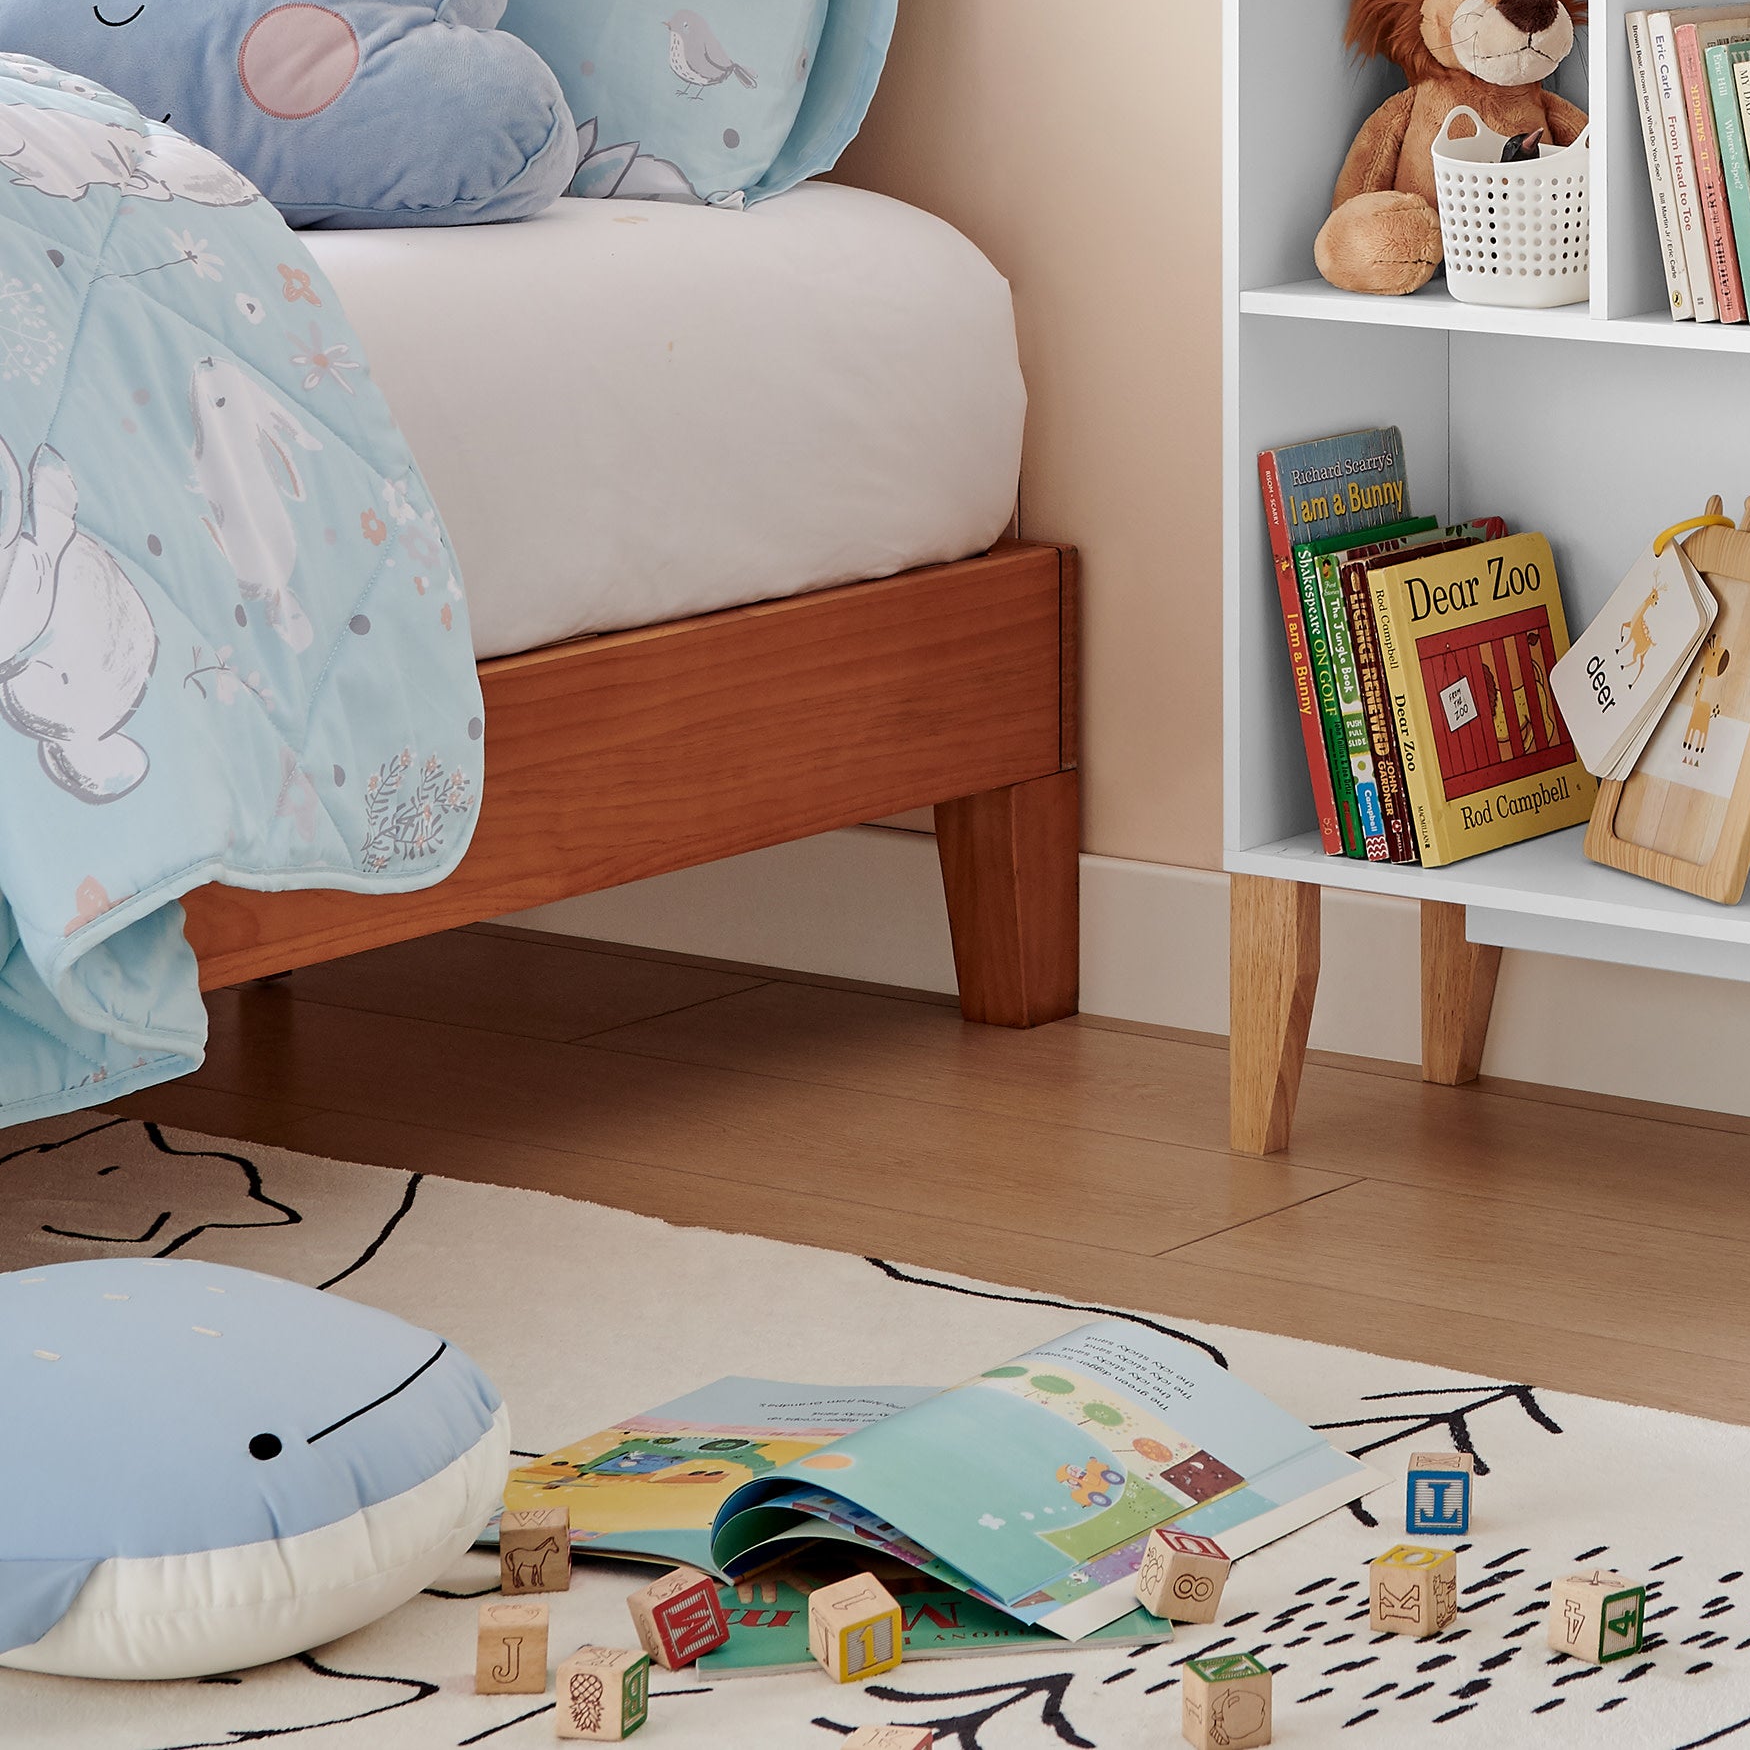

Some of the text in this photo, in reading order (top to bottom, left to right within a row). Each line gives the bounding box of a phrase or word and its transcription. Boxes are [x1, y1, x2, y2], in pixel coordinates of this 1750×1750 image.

[1632, 25, 1640, 49] Brown
[1640, 70, 1648, 92] Brown
[1655, 35, 1672, 99] Eric Carle
[1713, 54, 1728, 97] Eric Hill
[1740, 70, 1750, 86] MY
[1647, 115, 1655, 135] What
[1691, 84, 1706, 141] SALINGER
[1650, 135, 1656, 147] Do
[1668, 116, 1692, 231] From Head to Toe
[1731, 160, 1744, 190] Spot?
[1704, 181, 1717, 209] RYE
[1661, 205, 1670, 229] Martin
[1665, 230, 1671, 238] Jr
[1714, 237, 1731, 296] CATCHER
[1291, 450, 1393, 486] Richard Scarry's
[1270, 498, 1280, 525] SCARRY
[1289, 480, 1403, 525] I am a Bunny
[1298, 550, 1321, 635] Shakespeare
[1404, 556, 1541, 622] Dear Zoo
[1288, 622, 1301, 648] am
[1330, 598, 1353, 693] The Jungle Book
[1375, 590, 1399, 670] Rod Campbell
[1293, 652, 1303, 663] a
[1314, 639, 1328, 666] ON
[1296, 665, 1312, 715] Bunny
[1350, 593, 1389, 756] LICENCE RENEWED
[1586, 656, 1616, 713] deer
[1320, 670, 1337, 716] GOLF
[1449, 688, 1462, 702] FROM
[1453, 697, 1462, 708] THE
[1346, 720, 1362, 728] PUSH
[1455, 703, 1469, 720] ZOO
[1348, 729, 1363, 737] PULL
[1348, 738, 1367, 748] SLIDE
[1394, 693, 1416, 772] Dear Zoo
[1377, 761, 1394, 816] GARDNER
[1386, 760, 1398, 794] JOHN
[1364, 789, 1378, 832] Campbell
[1461, 776, 1570, 830] Rod Campbell
[1077, 1359, 1112, 1376] digger
[1093, 1355, 1172, 1400] the icky sticky
[1115, 1354, 1192, 1400] The icky sticky
[1117, 1344, 1195, 1388] the icky sticky
[1115, 1377, 1149, 1397] green
[1150, 1397, 1168, 1412] The
[1379, 1582, 1420, 1623] K
[491, 1637, 523, 1684] J
